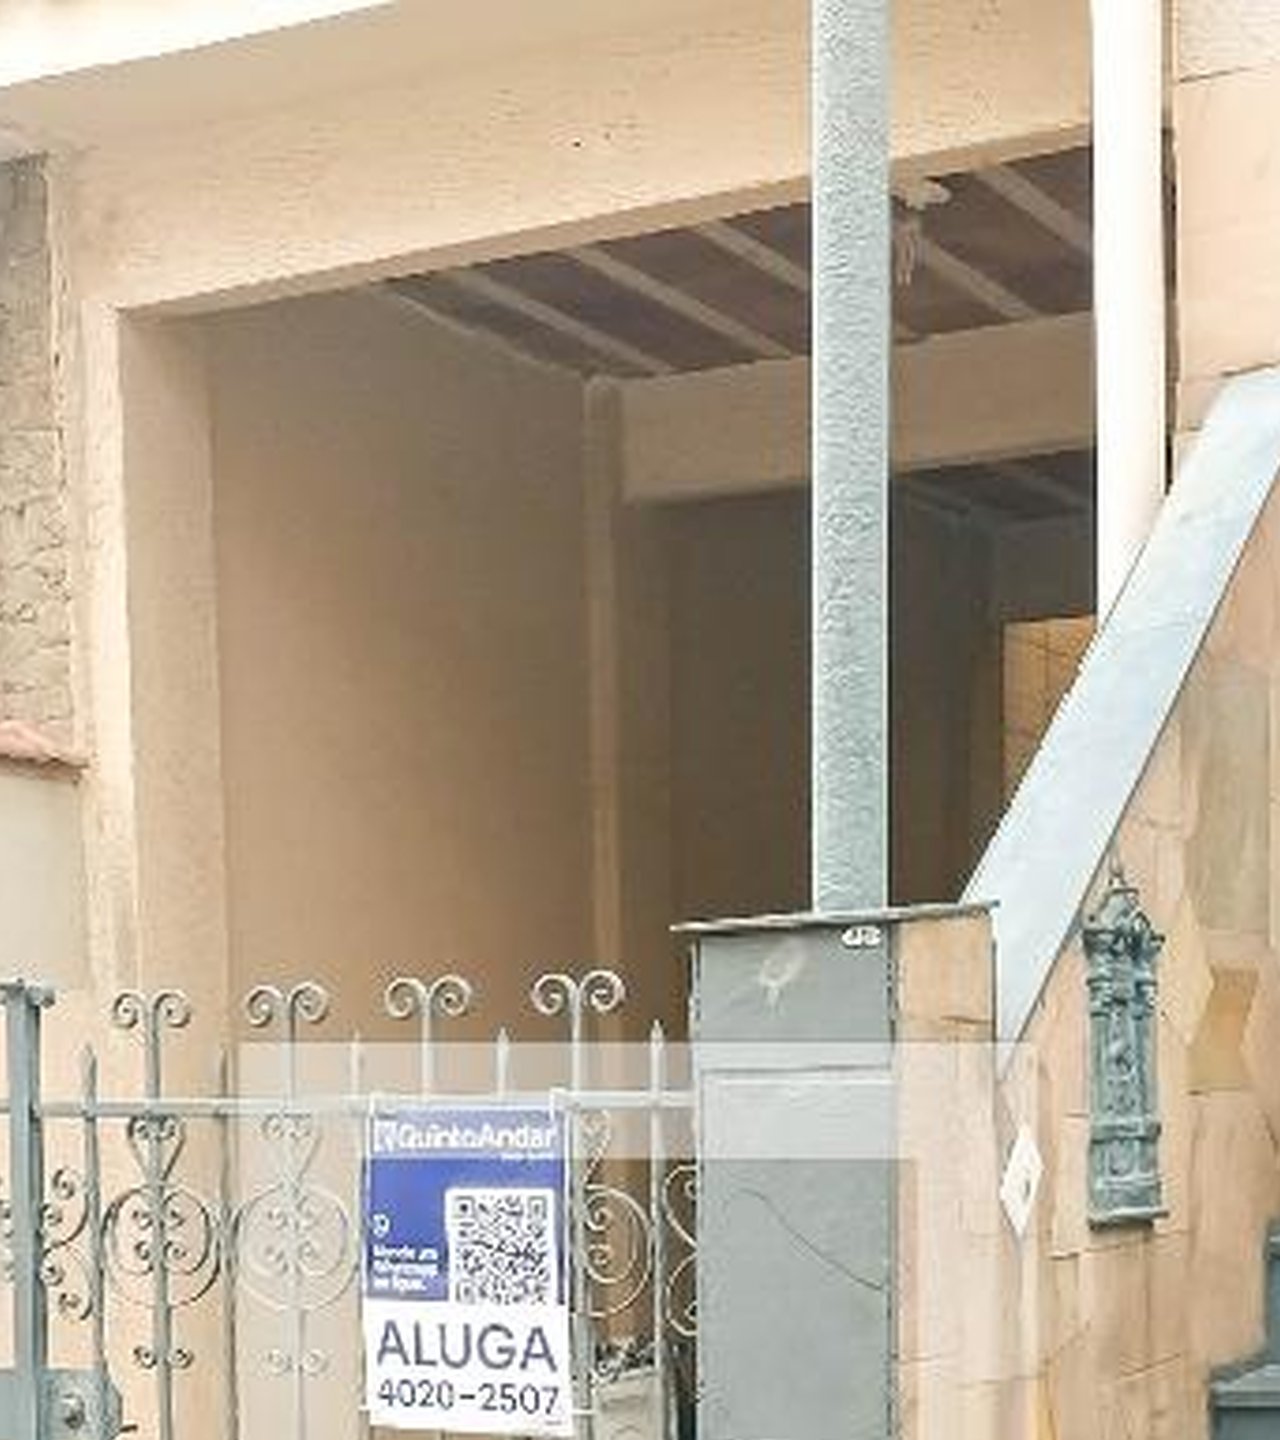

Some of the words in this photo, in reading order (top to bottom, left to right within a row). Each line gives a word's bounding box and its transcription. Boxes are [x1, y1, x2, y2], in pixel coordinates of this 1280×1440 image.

[398, 1123, 556, 1150] QuintoAndar
[377, 1320, 558, 1373] ALUGA
[378, 1379, 560, 1416] 4020-2507
